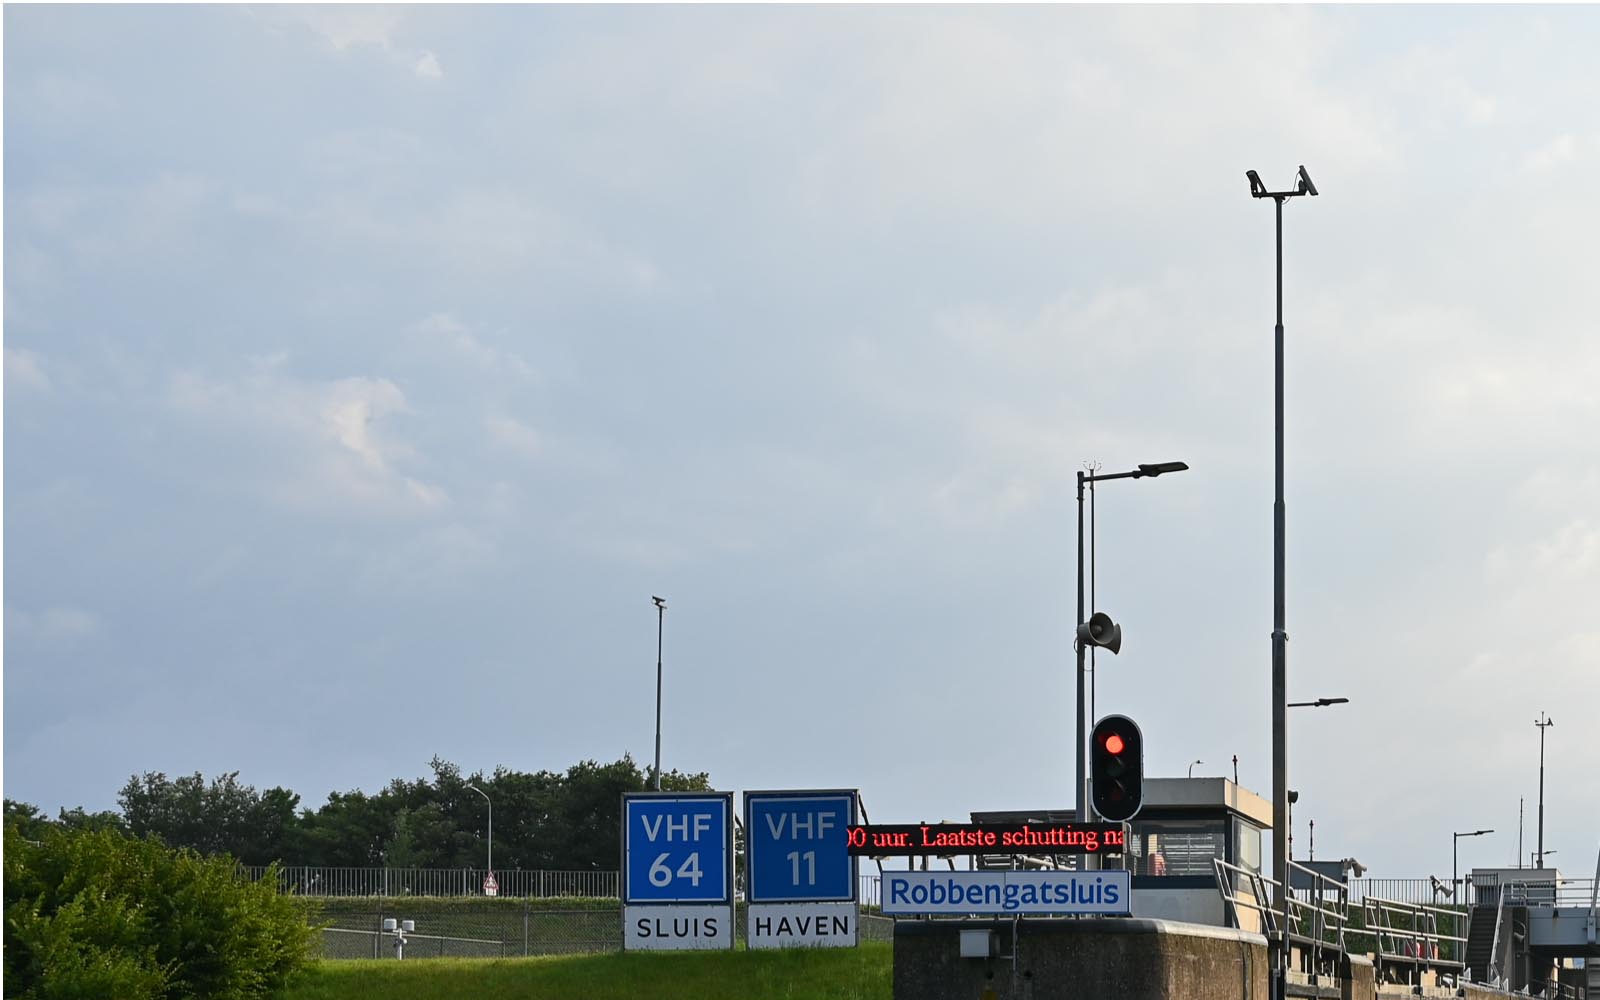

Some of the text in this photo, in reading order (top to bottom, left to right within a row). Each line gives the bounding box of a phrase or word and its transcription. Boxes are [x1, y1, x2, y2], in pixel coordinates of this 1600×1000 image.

[641, 814, 711, 842] VHF
[765, 811, 836, 840] VHF
[872, 832, 913, 848] uur.
[920, 826, 997, 848] Laatste
[1002, 825, 1100, 851] schutting
[648, 852, 703, 887] 64
[787, 850, 816, 886] 11
[890, 877, 1119, 910] Robbengatsluis
[637, 917, 718, 938] SLUIS
[755, 915, 848, 937] HAVEN
